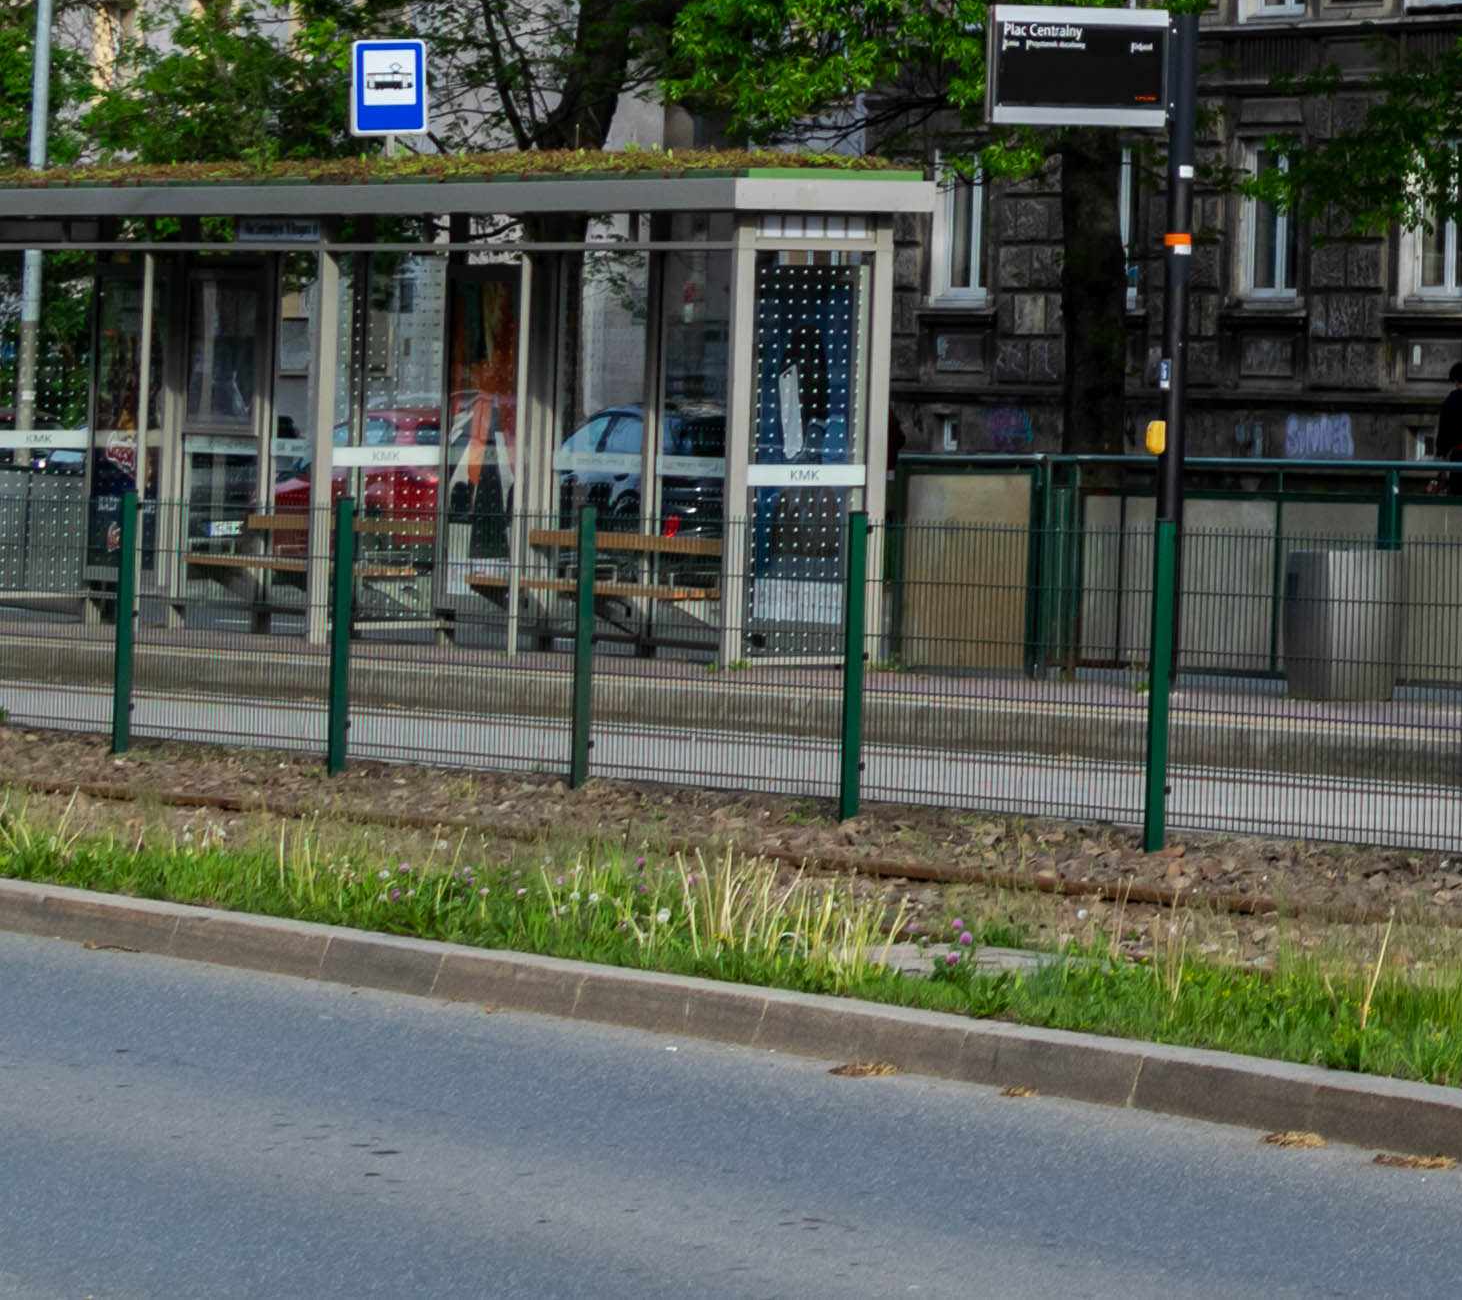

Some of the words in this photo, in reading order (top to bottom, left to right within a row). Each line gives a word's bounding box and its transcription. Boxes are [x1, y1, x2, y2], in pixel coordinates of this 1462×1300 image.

[1003, 22, 1027, 37] Plac
[1029, 23, 1083, 40] Centralny
[371, 450, 400, 462] KMK
[790, 469, 820, 481] KMK
